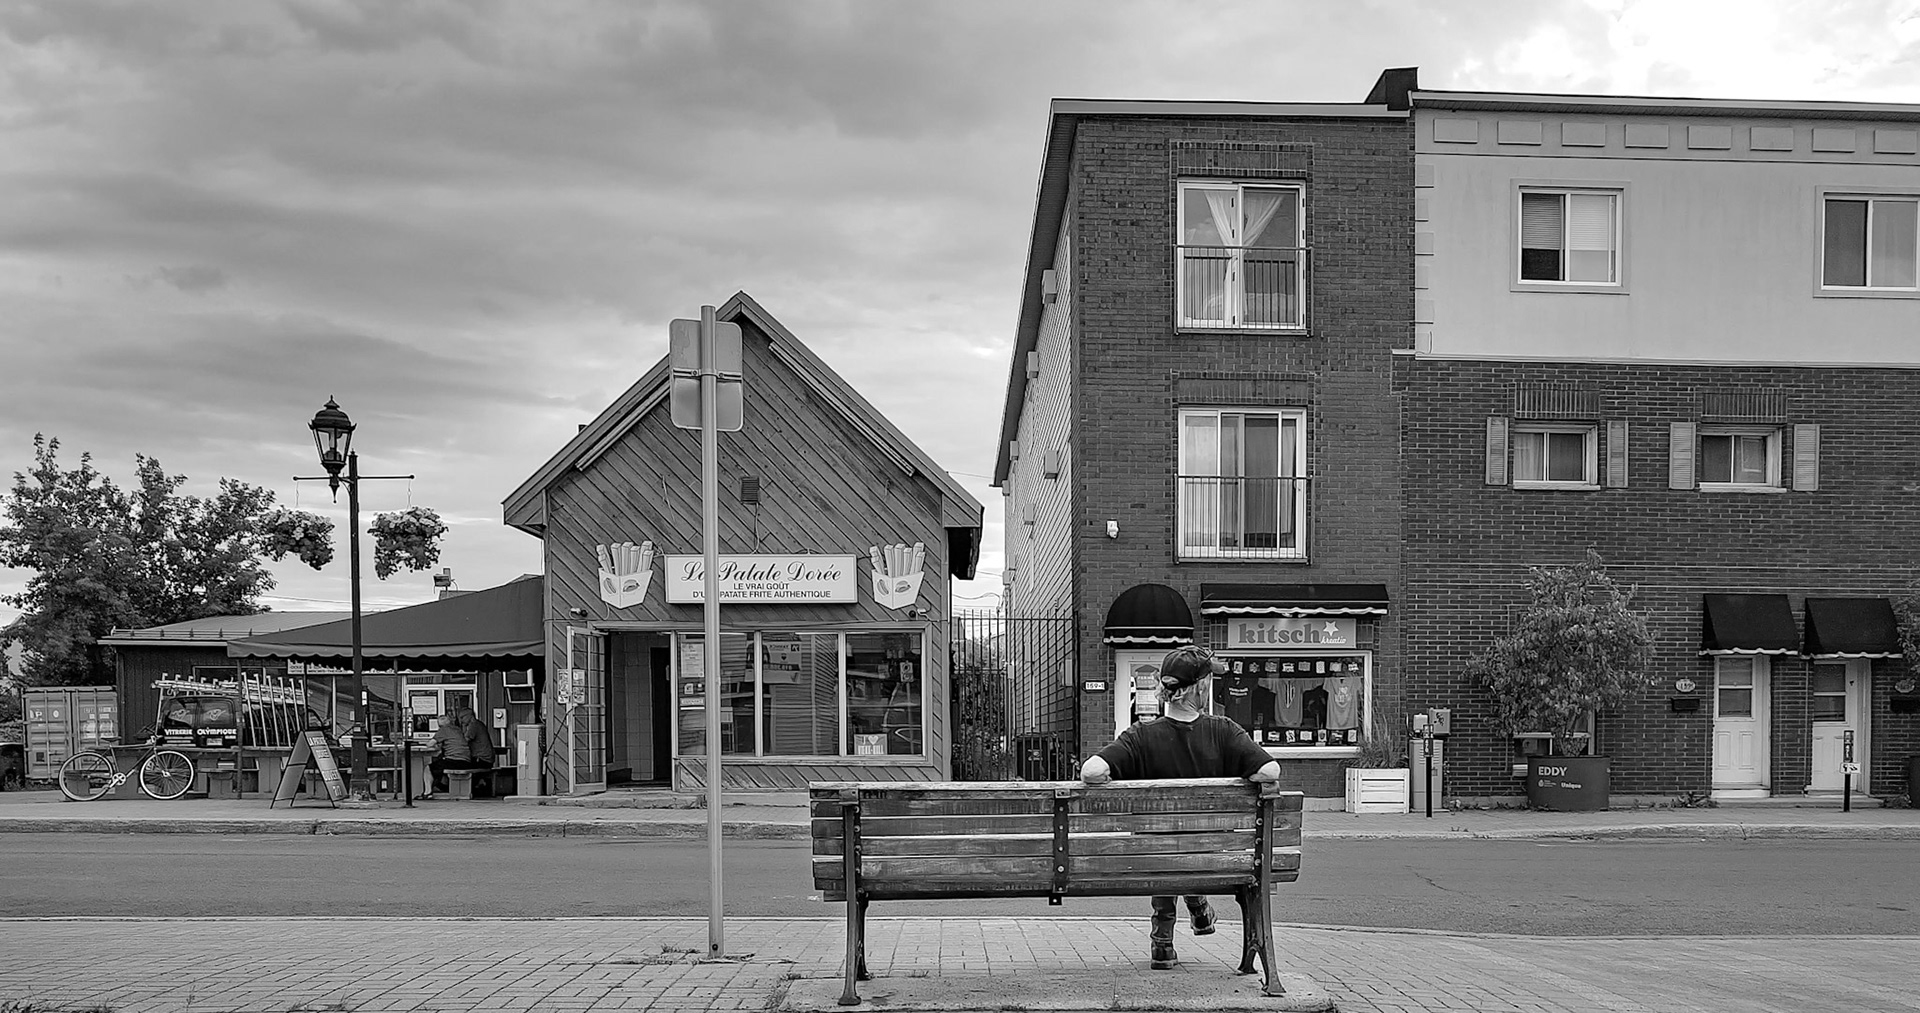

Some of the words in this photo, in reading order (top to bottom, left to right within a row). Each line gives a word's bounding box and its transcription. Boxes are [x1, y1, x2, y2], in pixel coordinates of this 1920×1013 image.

[718, 561, 781, 581] Patate
[787, 561, 842, 581] Dorée
[766, 581, 790, 590] GOÛT
[1238, 622, 1320, 644] kitsch
[1538, 766, 1568, 776] EDDY
